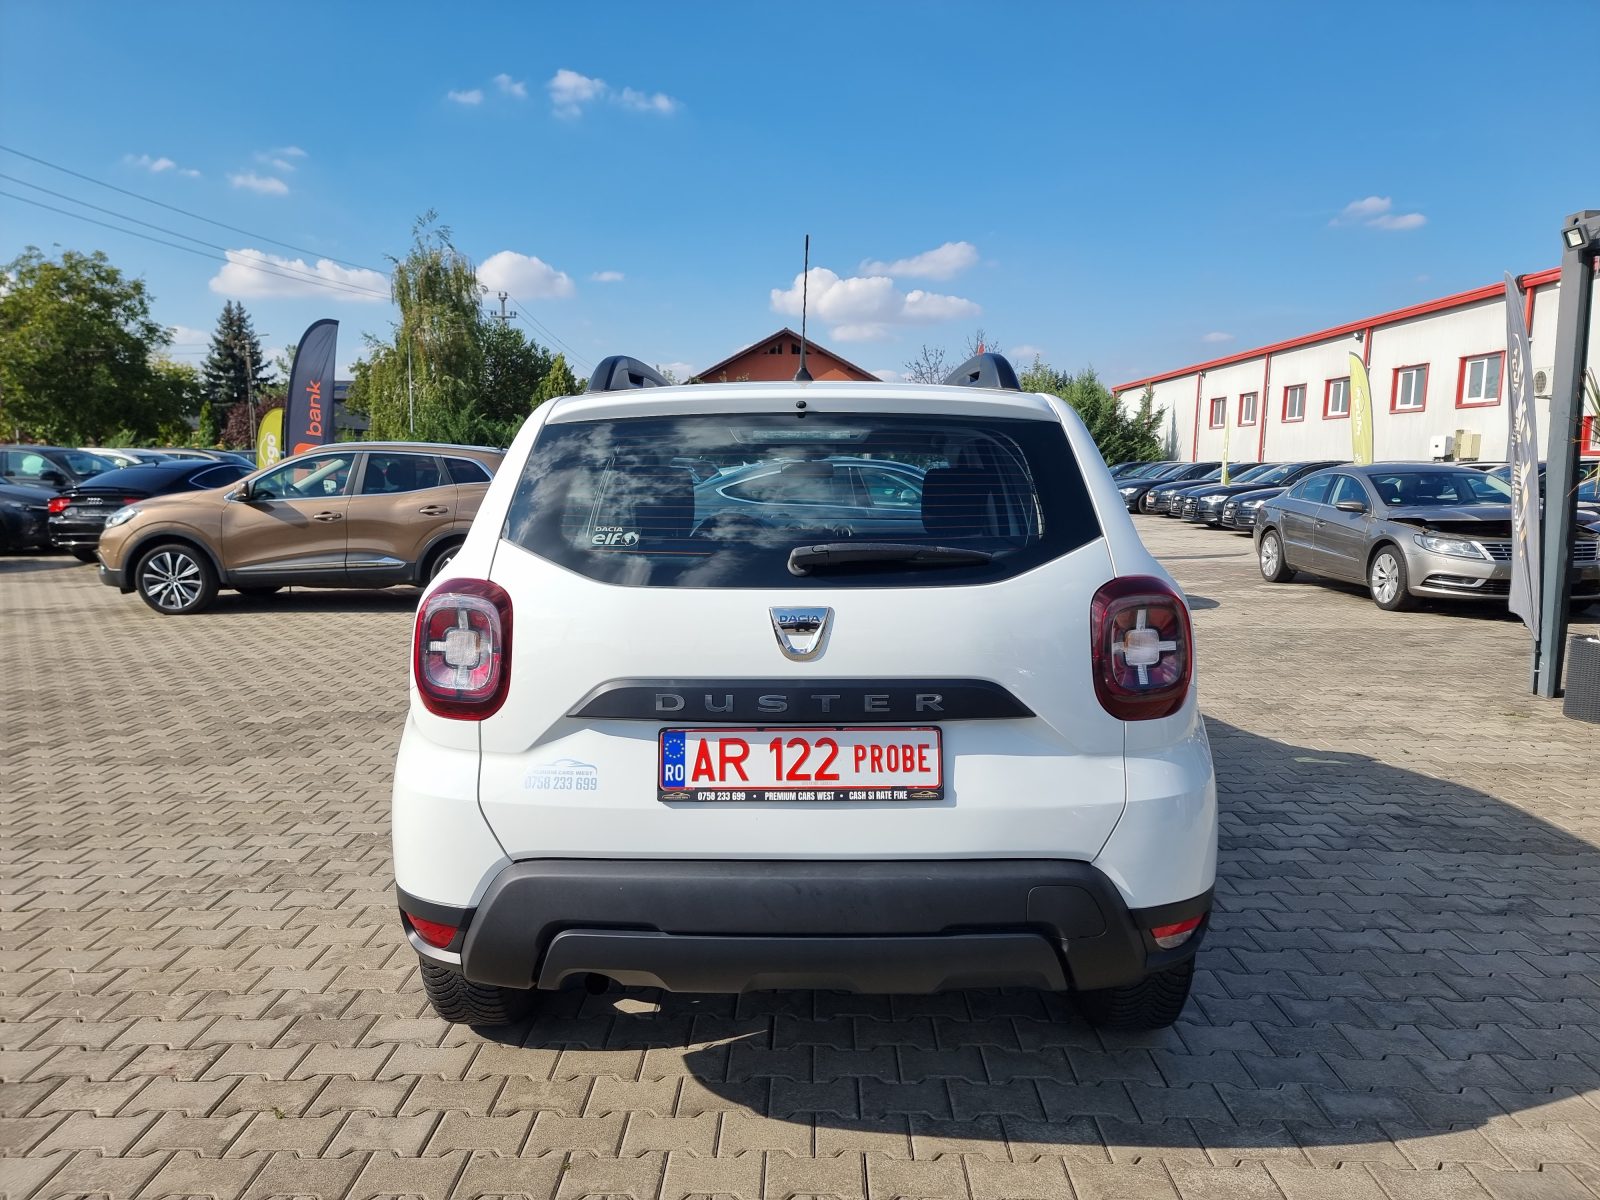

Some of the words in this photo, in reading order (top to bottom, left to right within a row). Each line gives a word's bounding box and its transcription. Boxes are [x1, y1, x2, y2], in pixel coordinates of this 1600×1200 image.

[305, 380, 322, 437] bank
[591, 532, 623, 545] elf
[779, 615, 821, 623] DACIA
[655, 693, 945, 713] DUSTER
[691, 738, 750, 782] AR
[769, 737, 840, 781] 122
[853, 744, 932, 773] PROBE
[665, 764, 684, 782] RO
[524, 775, 551, 790] 0758
[552, 776, 574, 790] 233
[575, 777, 598, 791] 699
[697, 791, 716, 801] 0758
[717, 791, 731, 801] 233
[732, 791, 746, 801] 699
[764, 791, 797, 801] PREMIUM
[797, 791, 815, 801] CARS
[816, 791, 835, 801] WEST
[848, 791, 867, 800] CASH
[867, 791, 875, 800] SI
[876, 791, 893, 800] RATE
[893, 790, 908, 800] FIXE
